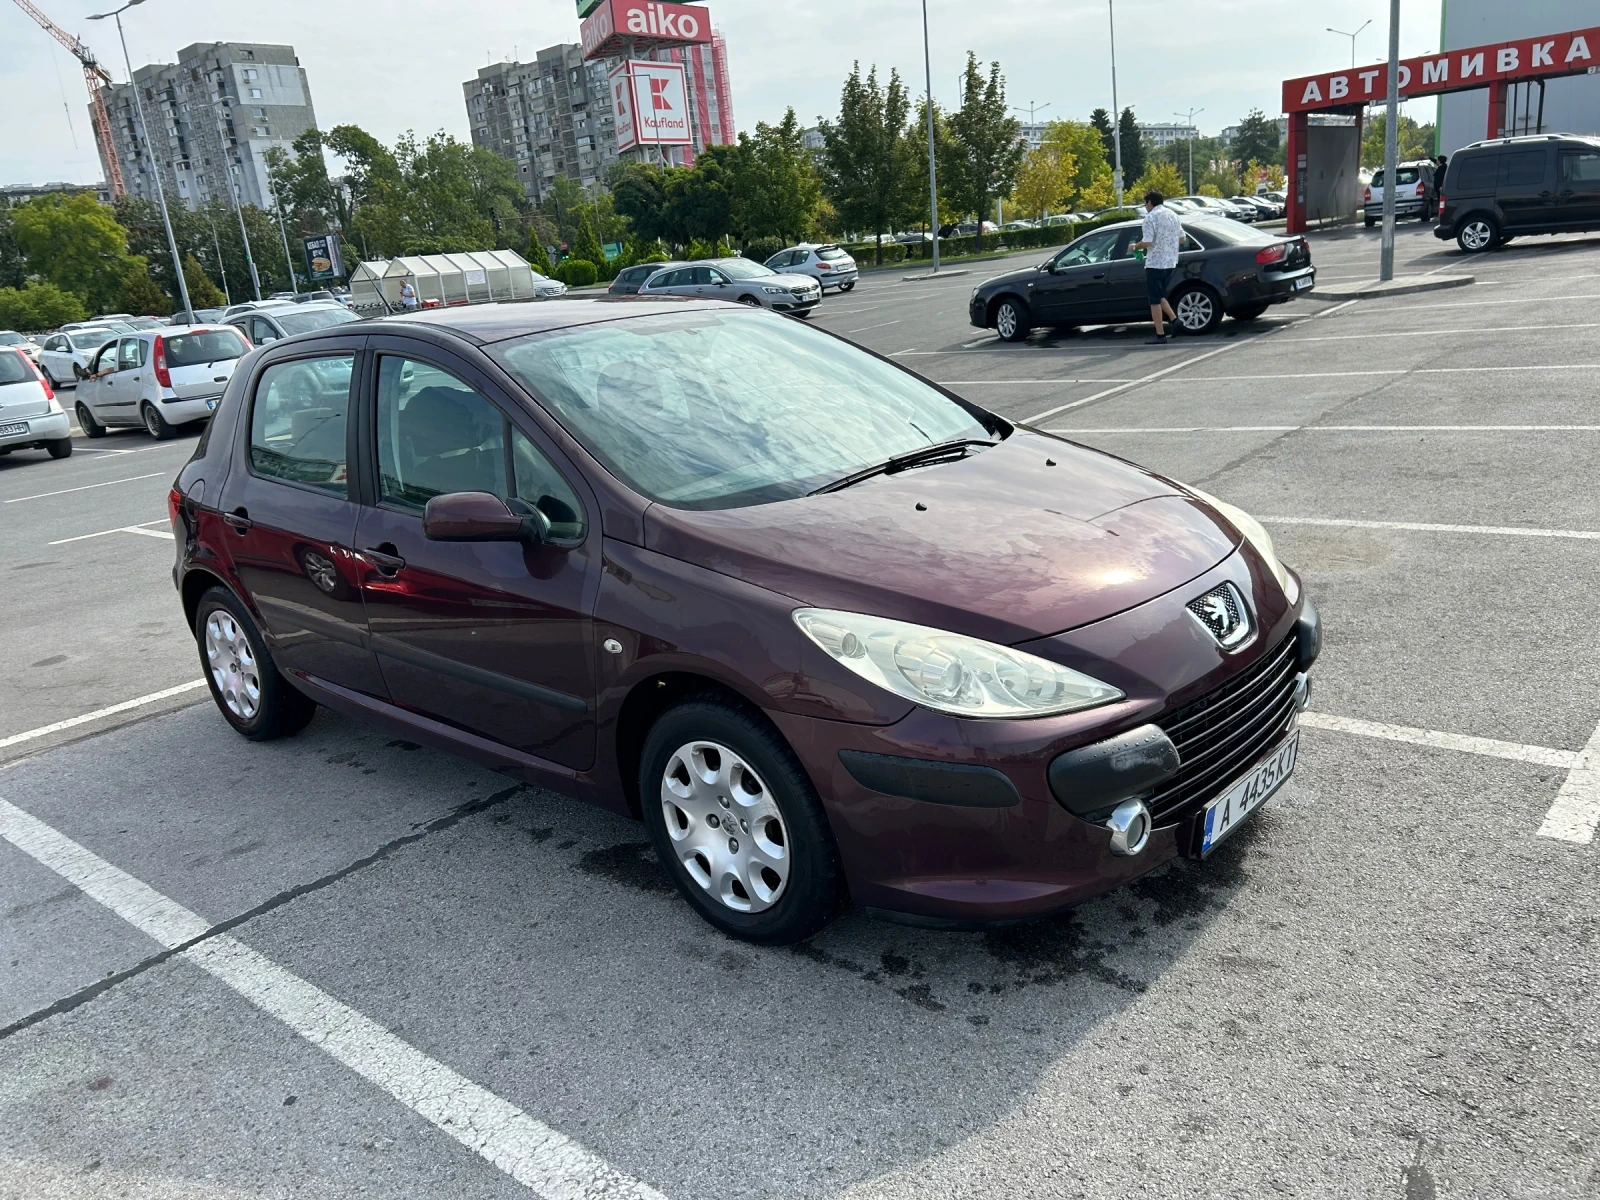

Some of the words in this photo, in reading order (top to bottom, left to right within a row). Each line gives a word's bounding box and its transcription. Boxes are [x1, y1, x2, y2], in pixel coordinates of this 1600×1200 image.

[627, 3, 698, 38] aiko
[1300, 36, 1591, 104] АВТОМИВКА
[644, 116, 684, 129] Kaufland
[1219, 798, 1231, 832] A
[1239, 738, 1296, 811] 4435KT
